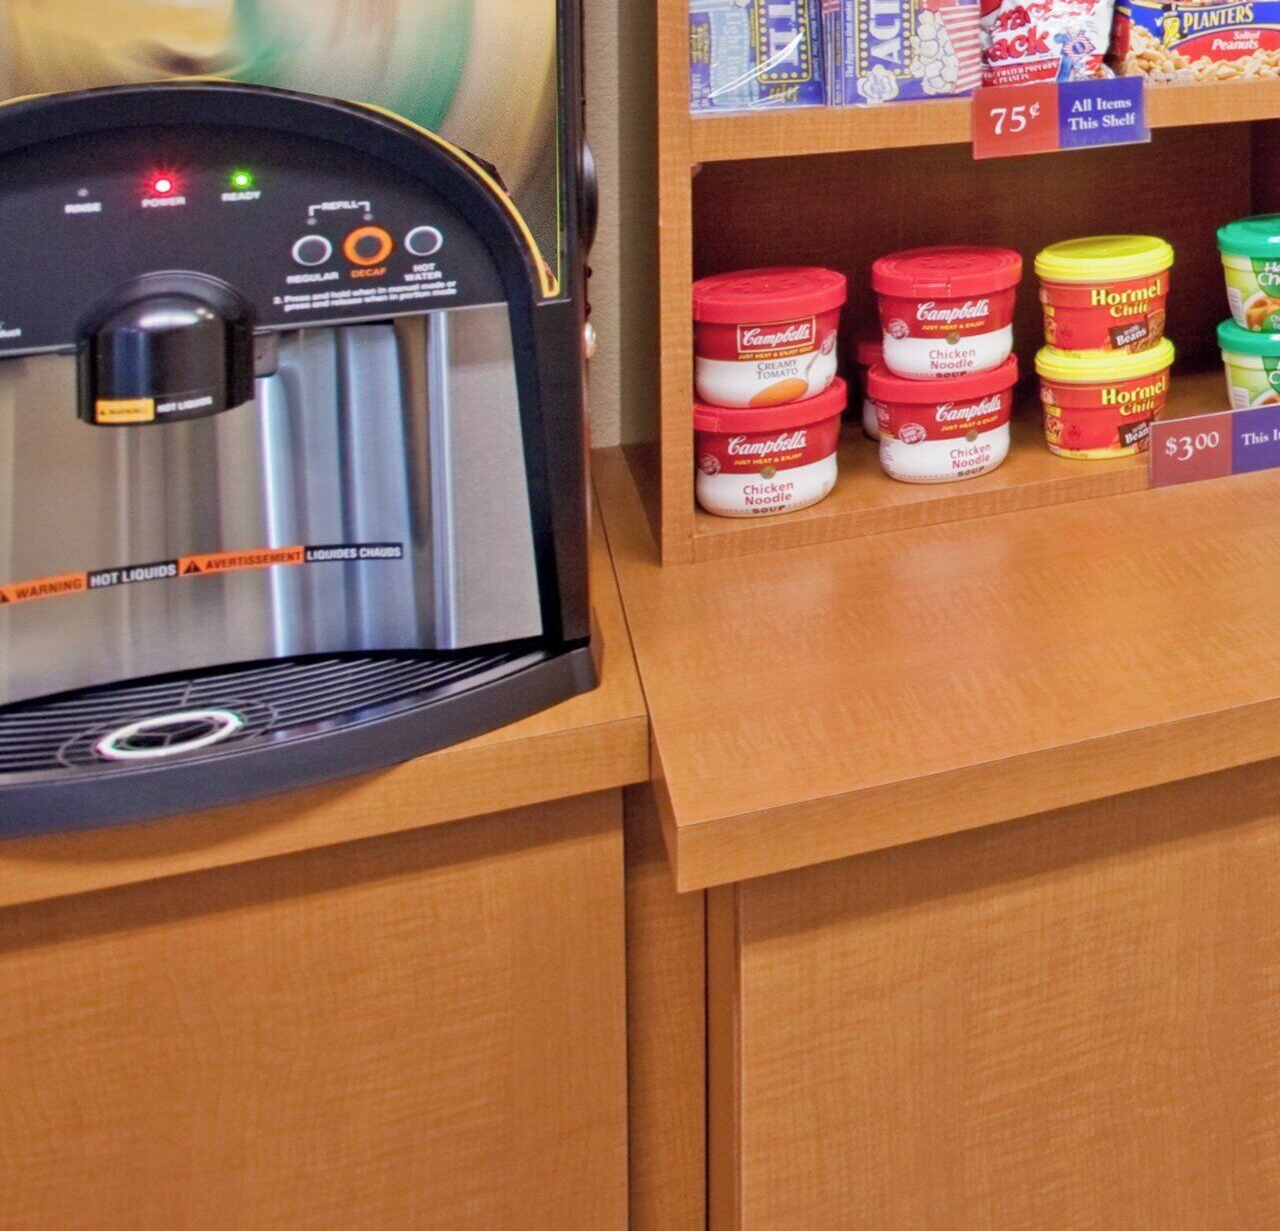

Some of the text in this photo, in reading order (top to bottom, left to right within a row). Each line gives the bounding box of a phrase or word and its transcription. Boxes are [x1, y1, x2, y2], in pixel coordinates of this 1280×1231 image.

[1183, 4, 1255, 34] PLANTERS
[869, 0, 901, 64] ACT
[1211, 38, 1260, 51] Peanuts
[1072, 97, 1132, 112] All Items
[1068, 112, 1136, 131] This Shelf
[142, 196, 186, 208] POWER
[221, 191, 261, 202] READY
[322, 200, 358, 211] REFILL
[351, 267, 387, 278] DECAF
[413, 263, 435, 272] HOT
[286, 272, 339, 284] REGULAR
[404, 271, 442, 282] WATER
[1090, 280, 1162, 306] Hormel
[1110, 302, 1148, 318] Chili
[1116, 326, 1147, 347] Beans
[929, 348, 976, 359] Chicken
[756, 359, 797, 371] CREAMY
[930, 358, 974, 370] Noodle
[756, 368, 798, 380] TOMATO
[1101, 376, 1166, 406] Hormel
[1119, 399, 1154, 416] Chili
[1241, 433, 1270, 446] This
[743, 481, 794, 496] Chicken
[744, 492, 792, 505] Noodle
[205, 551, 300, 570] AVERTISSEMENT
[307, 546, 401, 561] LIQUIDES CHAUDS
[90, 564, 177, 587] HOT LIQUIDS
[15, 578, 82, 600] WARNING
